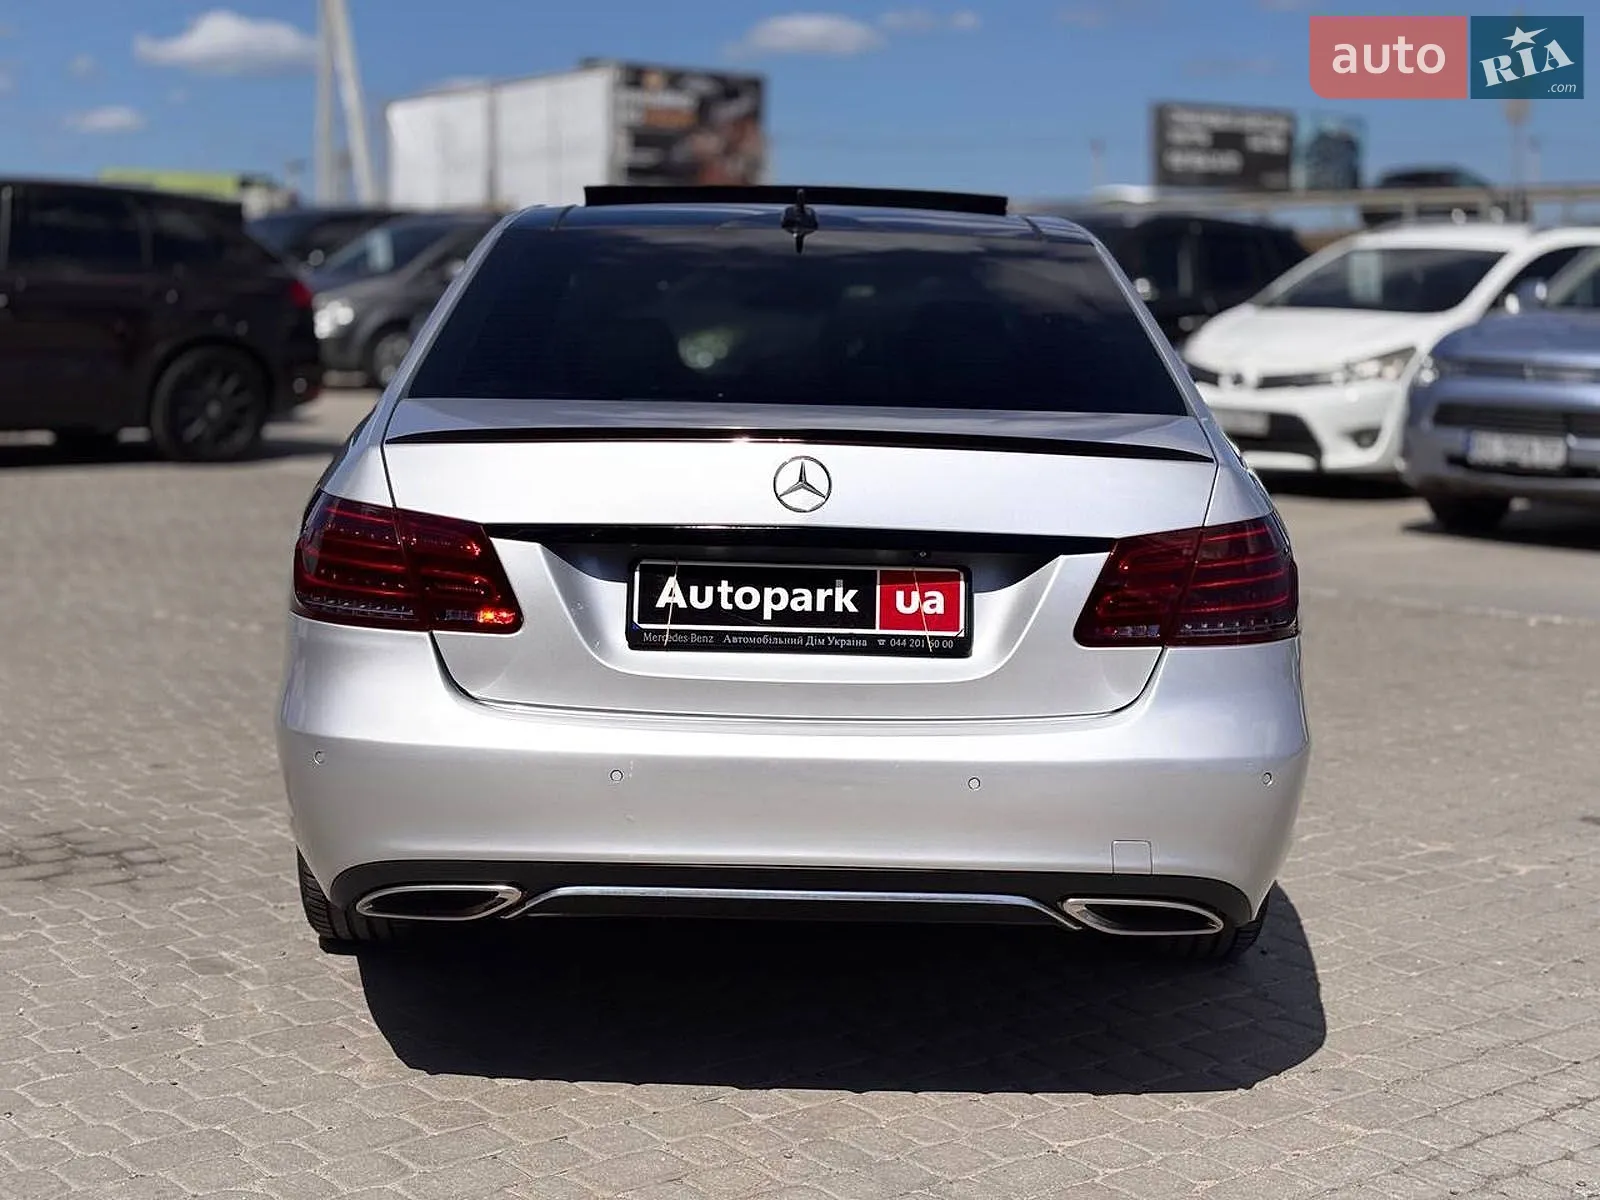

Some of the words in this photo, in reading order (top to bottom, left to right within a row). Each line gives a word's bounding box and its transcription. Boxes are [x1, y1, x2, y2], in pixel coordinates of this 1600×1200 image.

[656, 576, 859, 620] Autopark
[895, 589, 945, 615] ua
[643, 632, 714, 644] Mercedes-Benz
[723, 634, 804, 646] Автомобільний
[805, 635, 825, 647] Дім
[890, 638, 907, 648] 044
[909, 638, 925, 648] 201
[942, 639, 953, 649] 00
